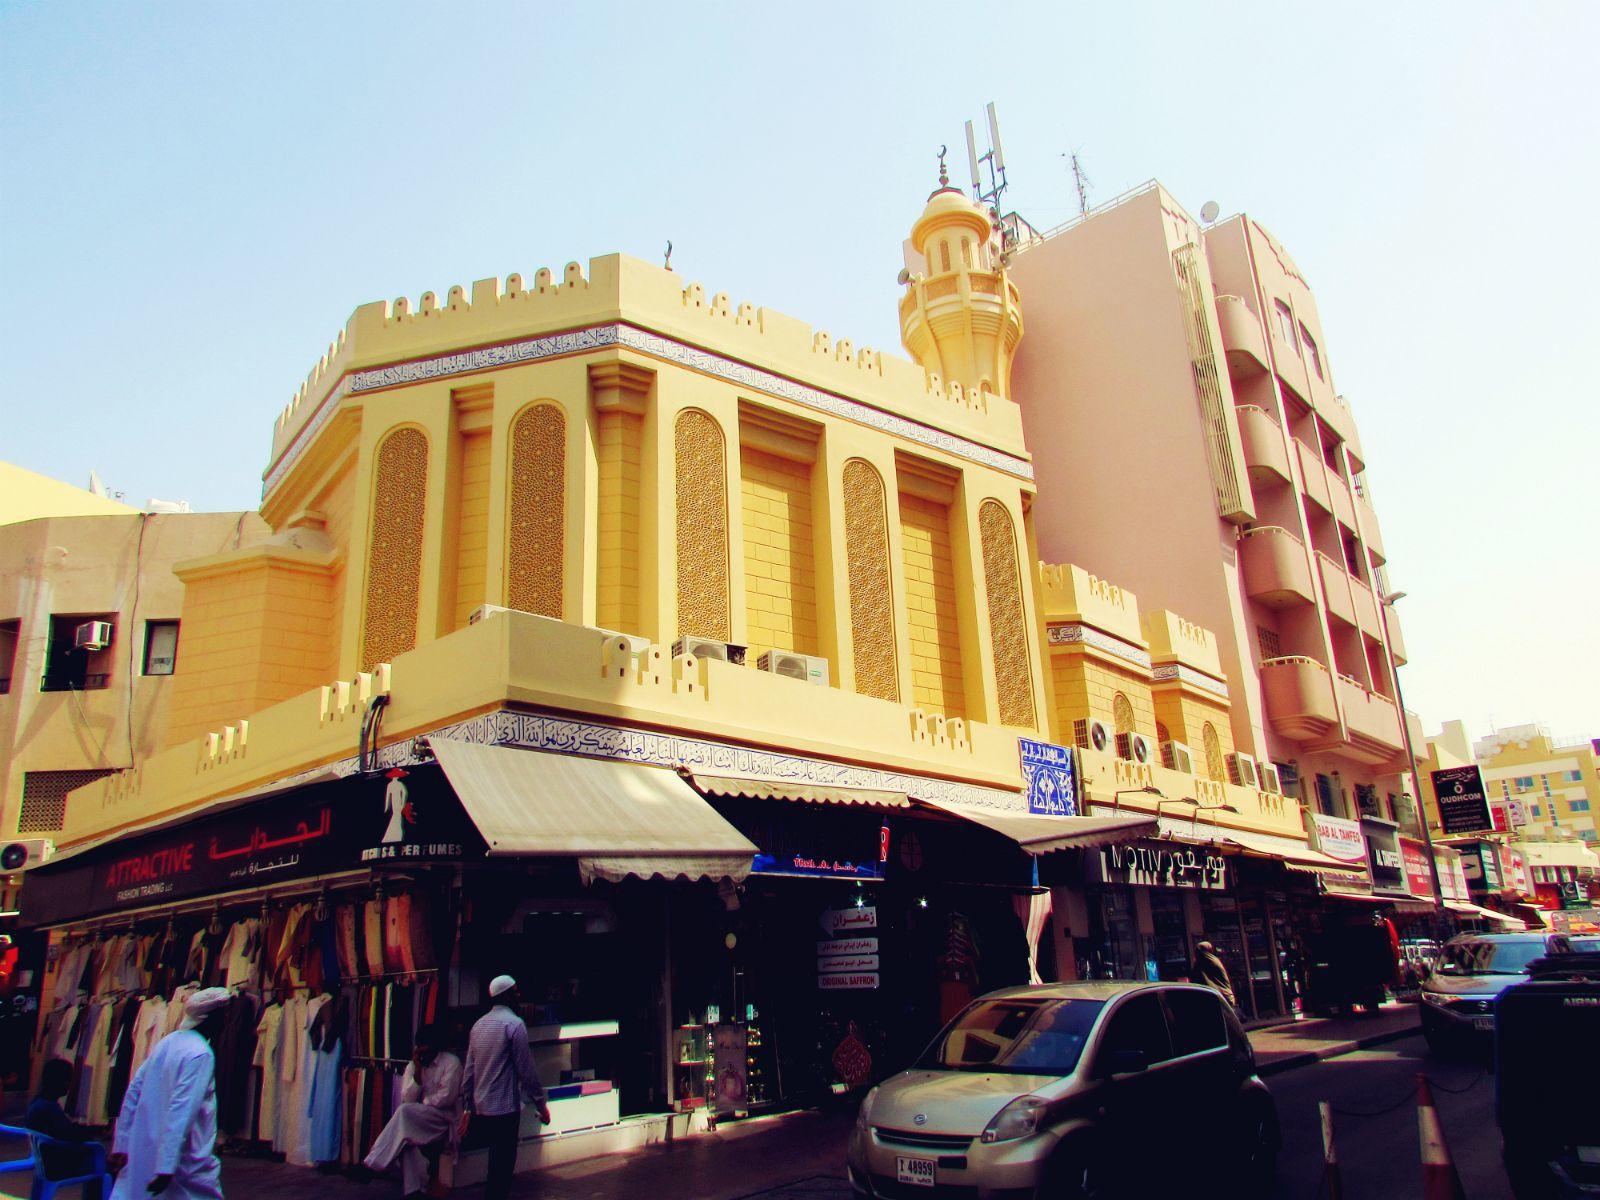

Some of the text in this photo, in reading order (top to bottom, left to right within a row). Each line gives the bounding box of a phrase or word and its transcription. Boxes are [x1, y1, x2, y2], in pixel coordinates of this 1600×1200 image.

[1440, 793, 1481, 804] OUDHCOM
[1330, 827, 1339, 839] AL
[389, 845, 396, 857] &
[401, 843, 462, 857] PERFUMES
[106, 842, 195, 888] ATTRACTIVE
[248, 853, 300, 876] للتجارة
[116, 886, 140, 901] FASHION
[140, 882, 165, 897] TRADING
[832, 910, 875, 928] زعفران
[822, 975, 875, 987] ORIGINAL SAFFRON
[908, 1160, 933, 1175] 48959
